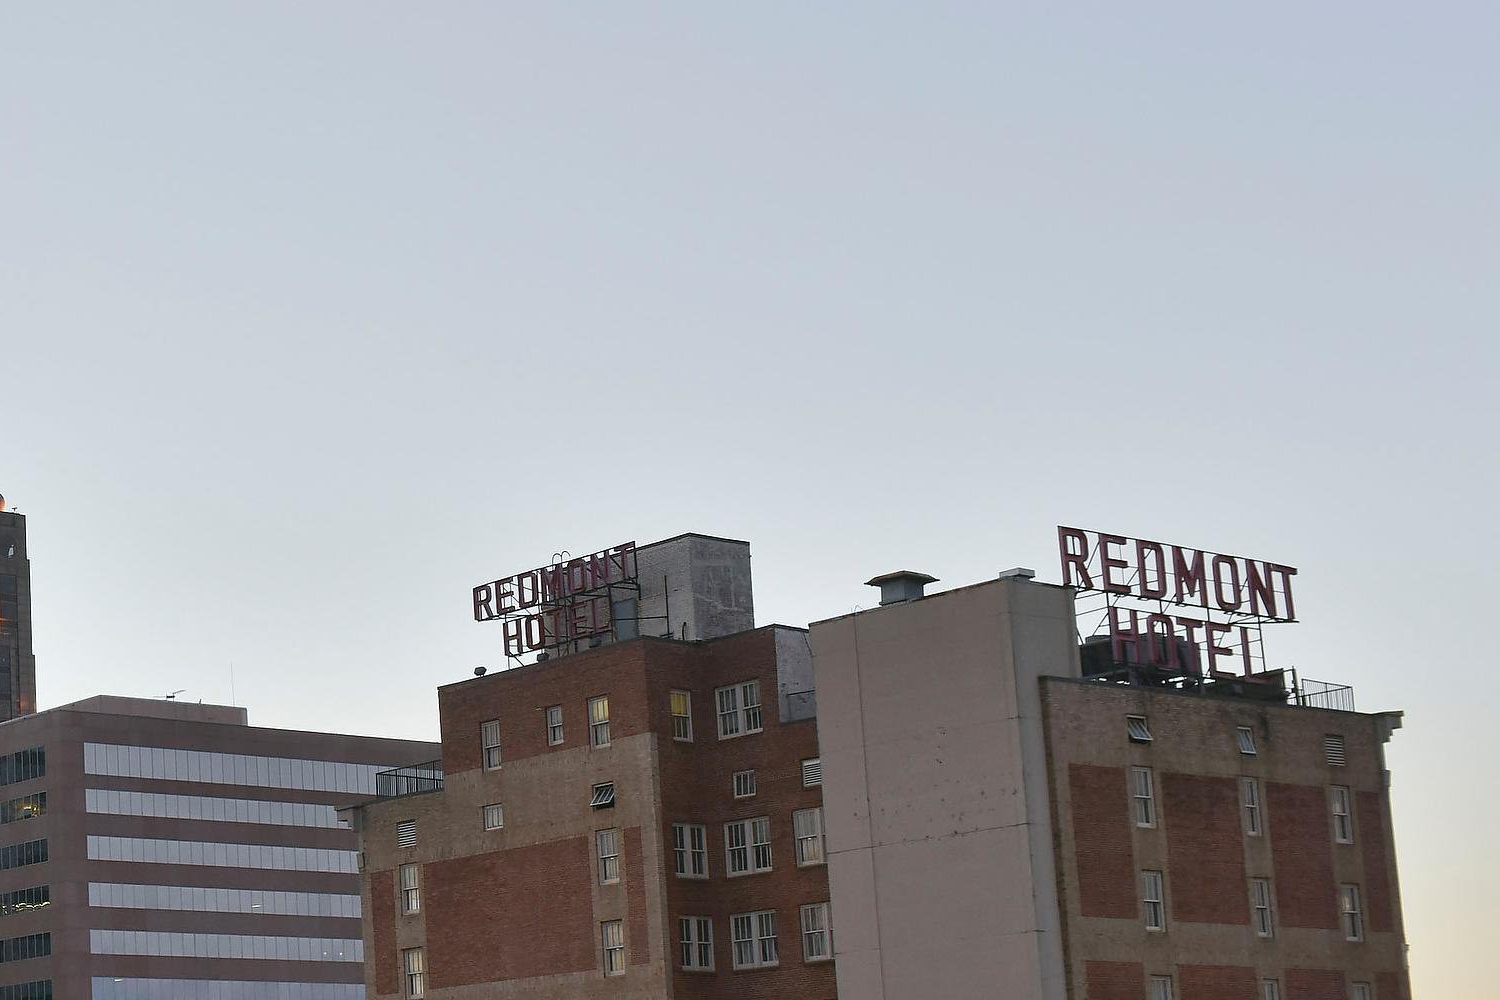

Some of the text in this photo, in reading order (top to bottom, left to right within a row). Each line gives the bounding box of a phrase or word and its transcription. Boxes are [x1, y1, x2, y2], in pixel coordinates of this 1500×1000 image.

[472, 541, 637, 621] REDMONT
[1057, 526, 1298, 621] REDMONT
[502, 598, 613, 657] HOTEL
[1108, 605, 1276, 684] HOTEL
